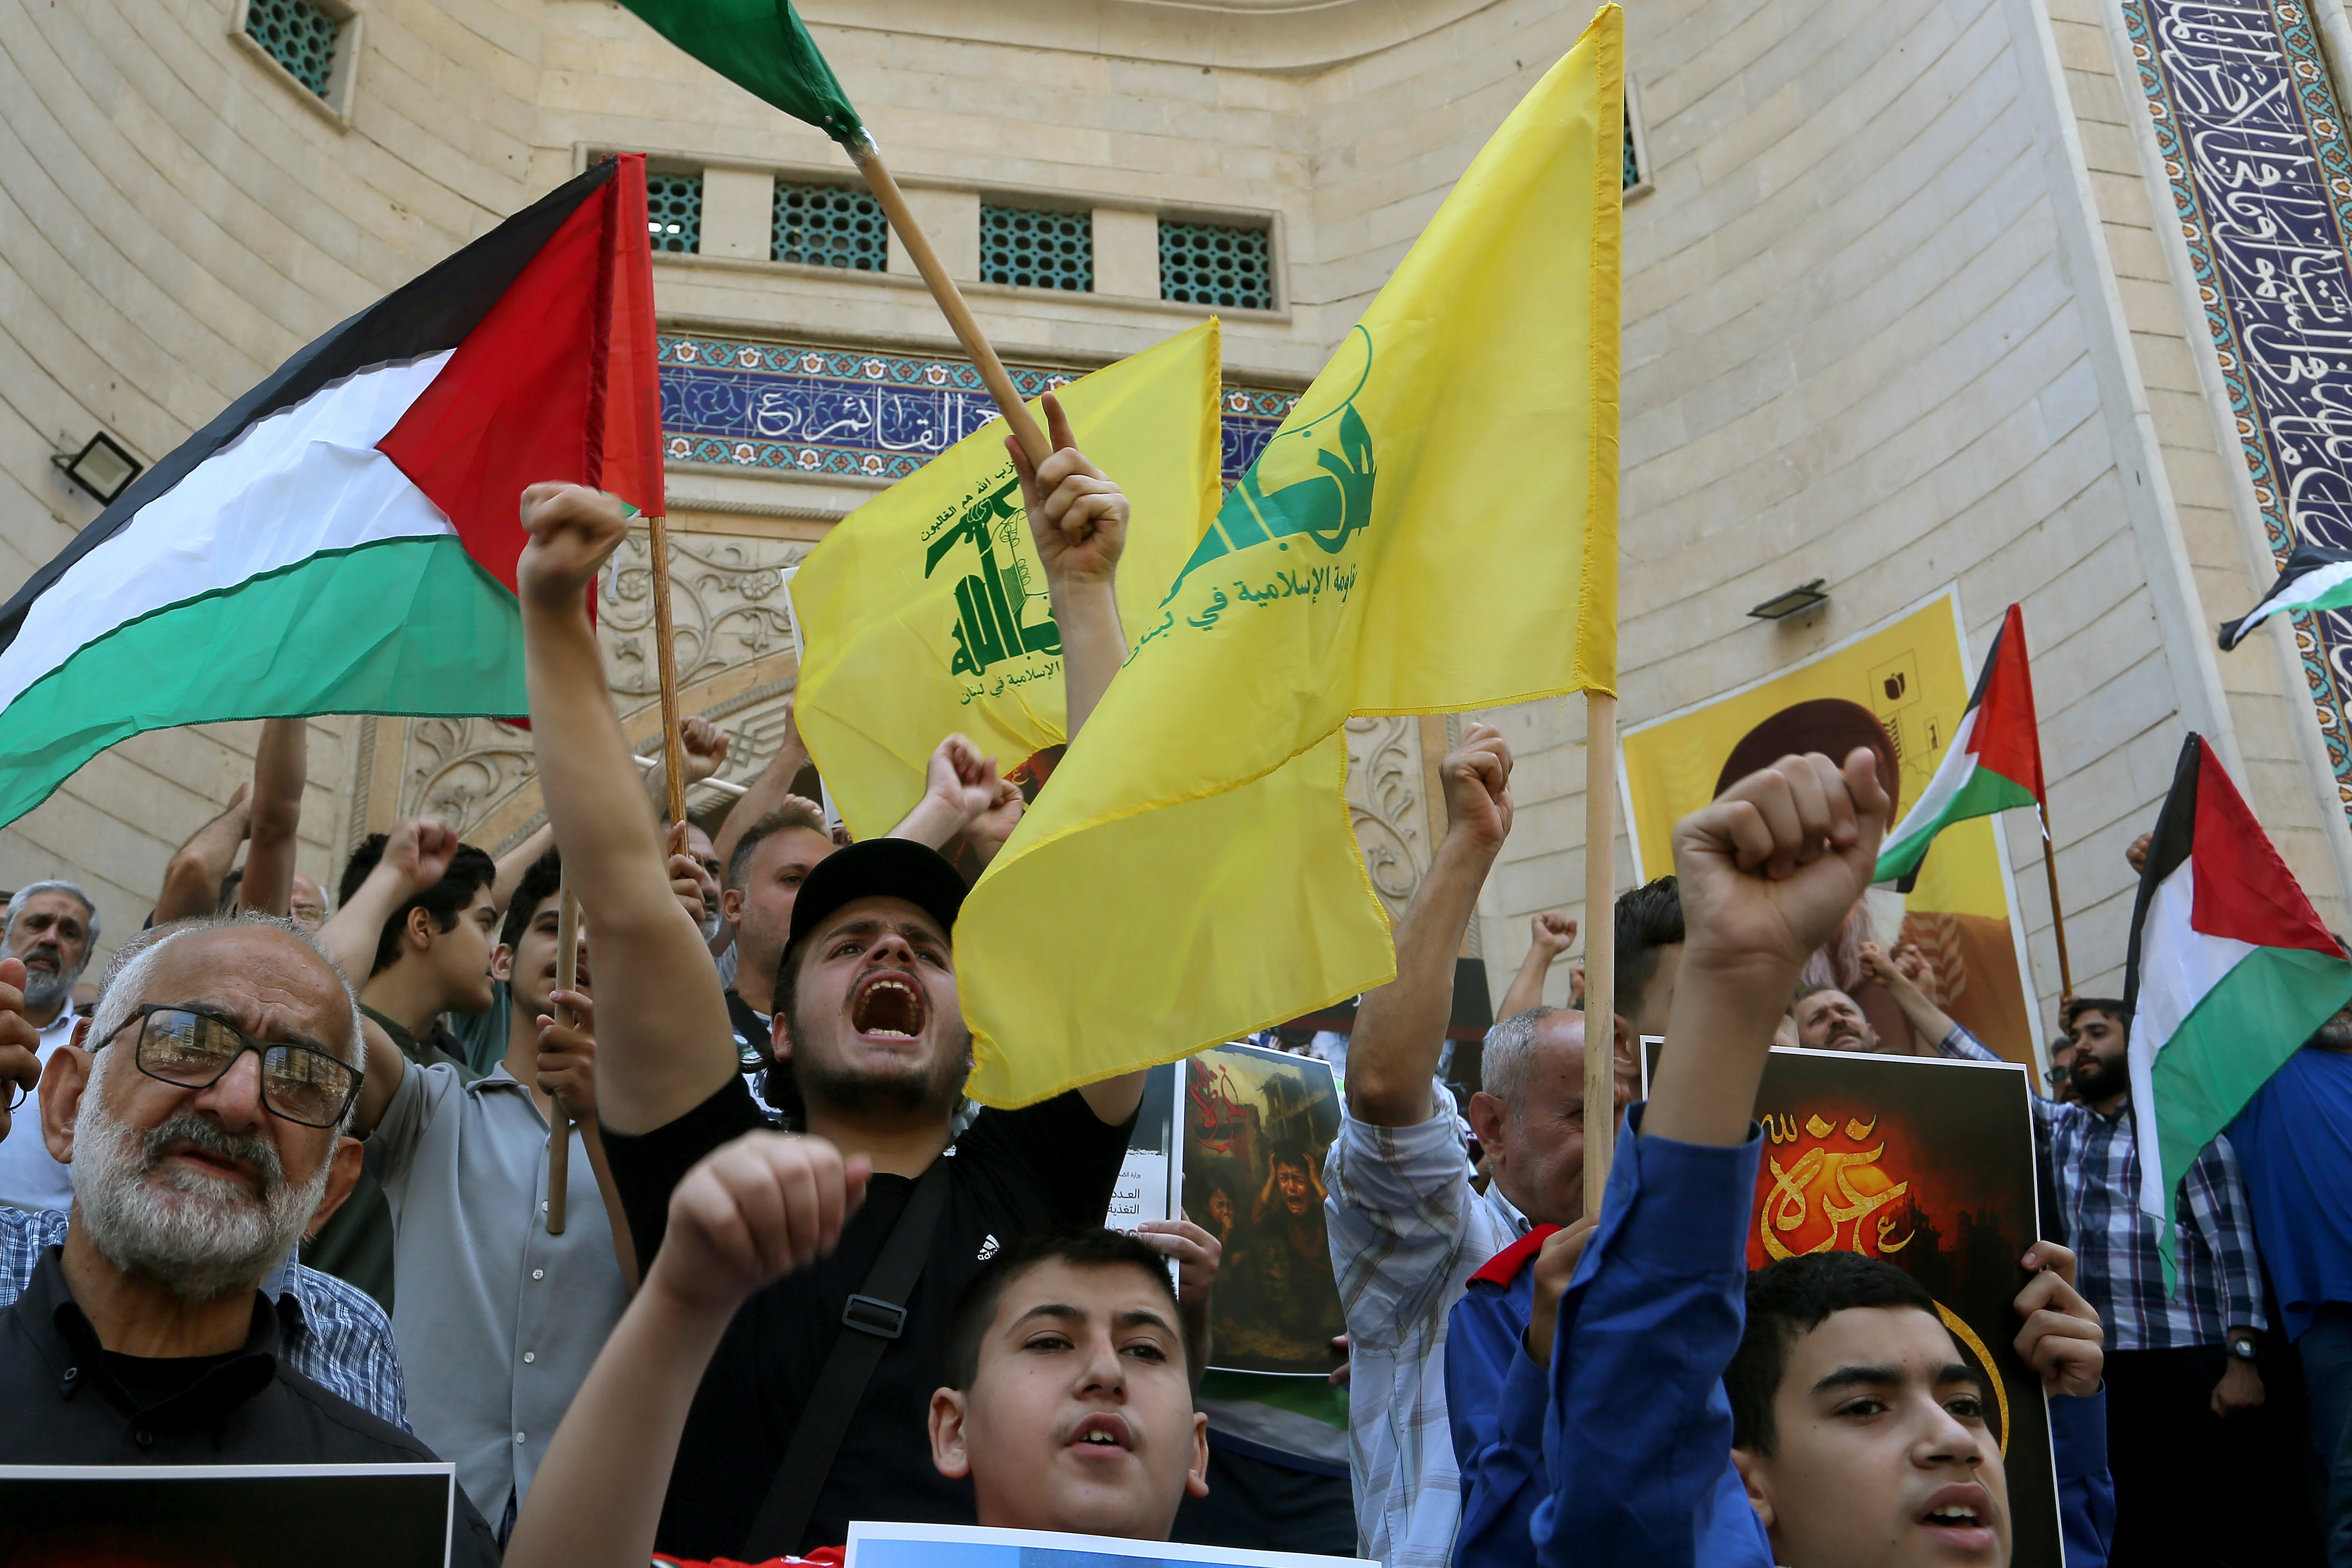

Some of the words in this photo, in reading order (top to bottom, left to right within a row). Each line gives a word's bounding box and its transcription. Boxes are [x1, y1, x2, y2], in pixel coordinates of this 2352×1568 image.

[920, 505, 957, 542] الغالبون
[1232, 565, 1330, 608] الإسلامية
[1009, 660, 1060, 687] الإسلامية
[960, 684, 985, 705] لبنان
[989, 677, 1004, 698] في
